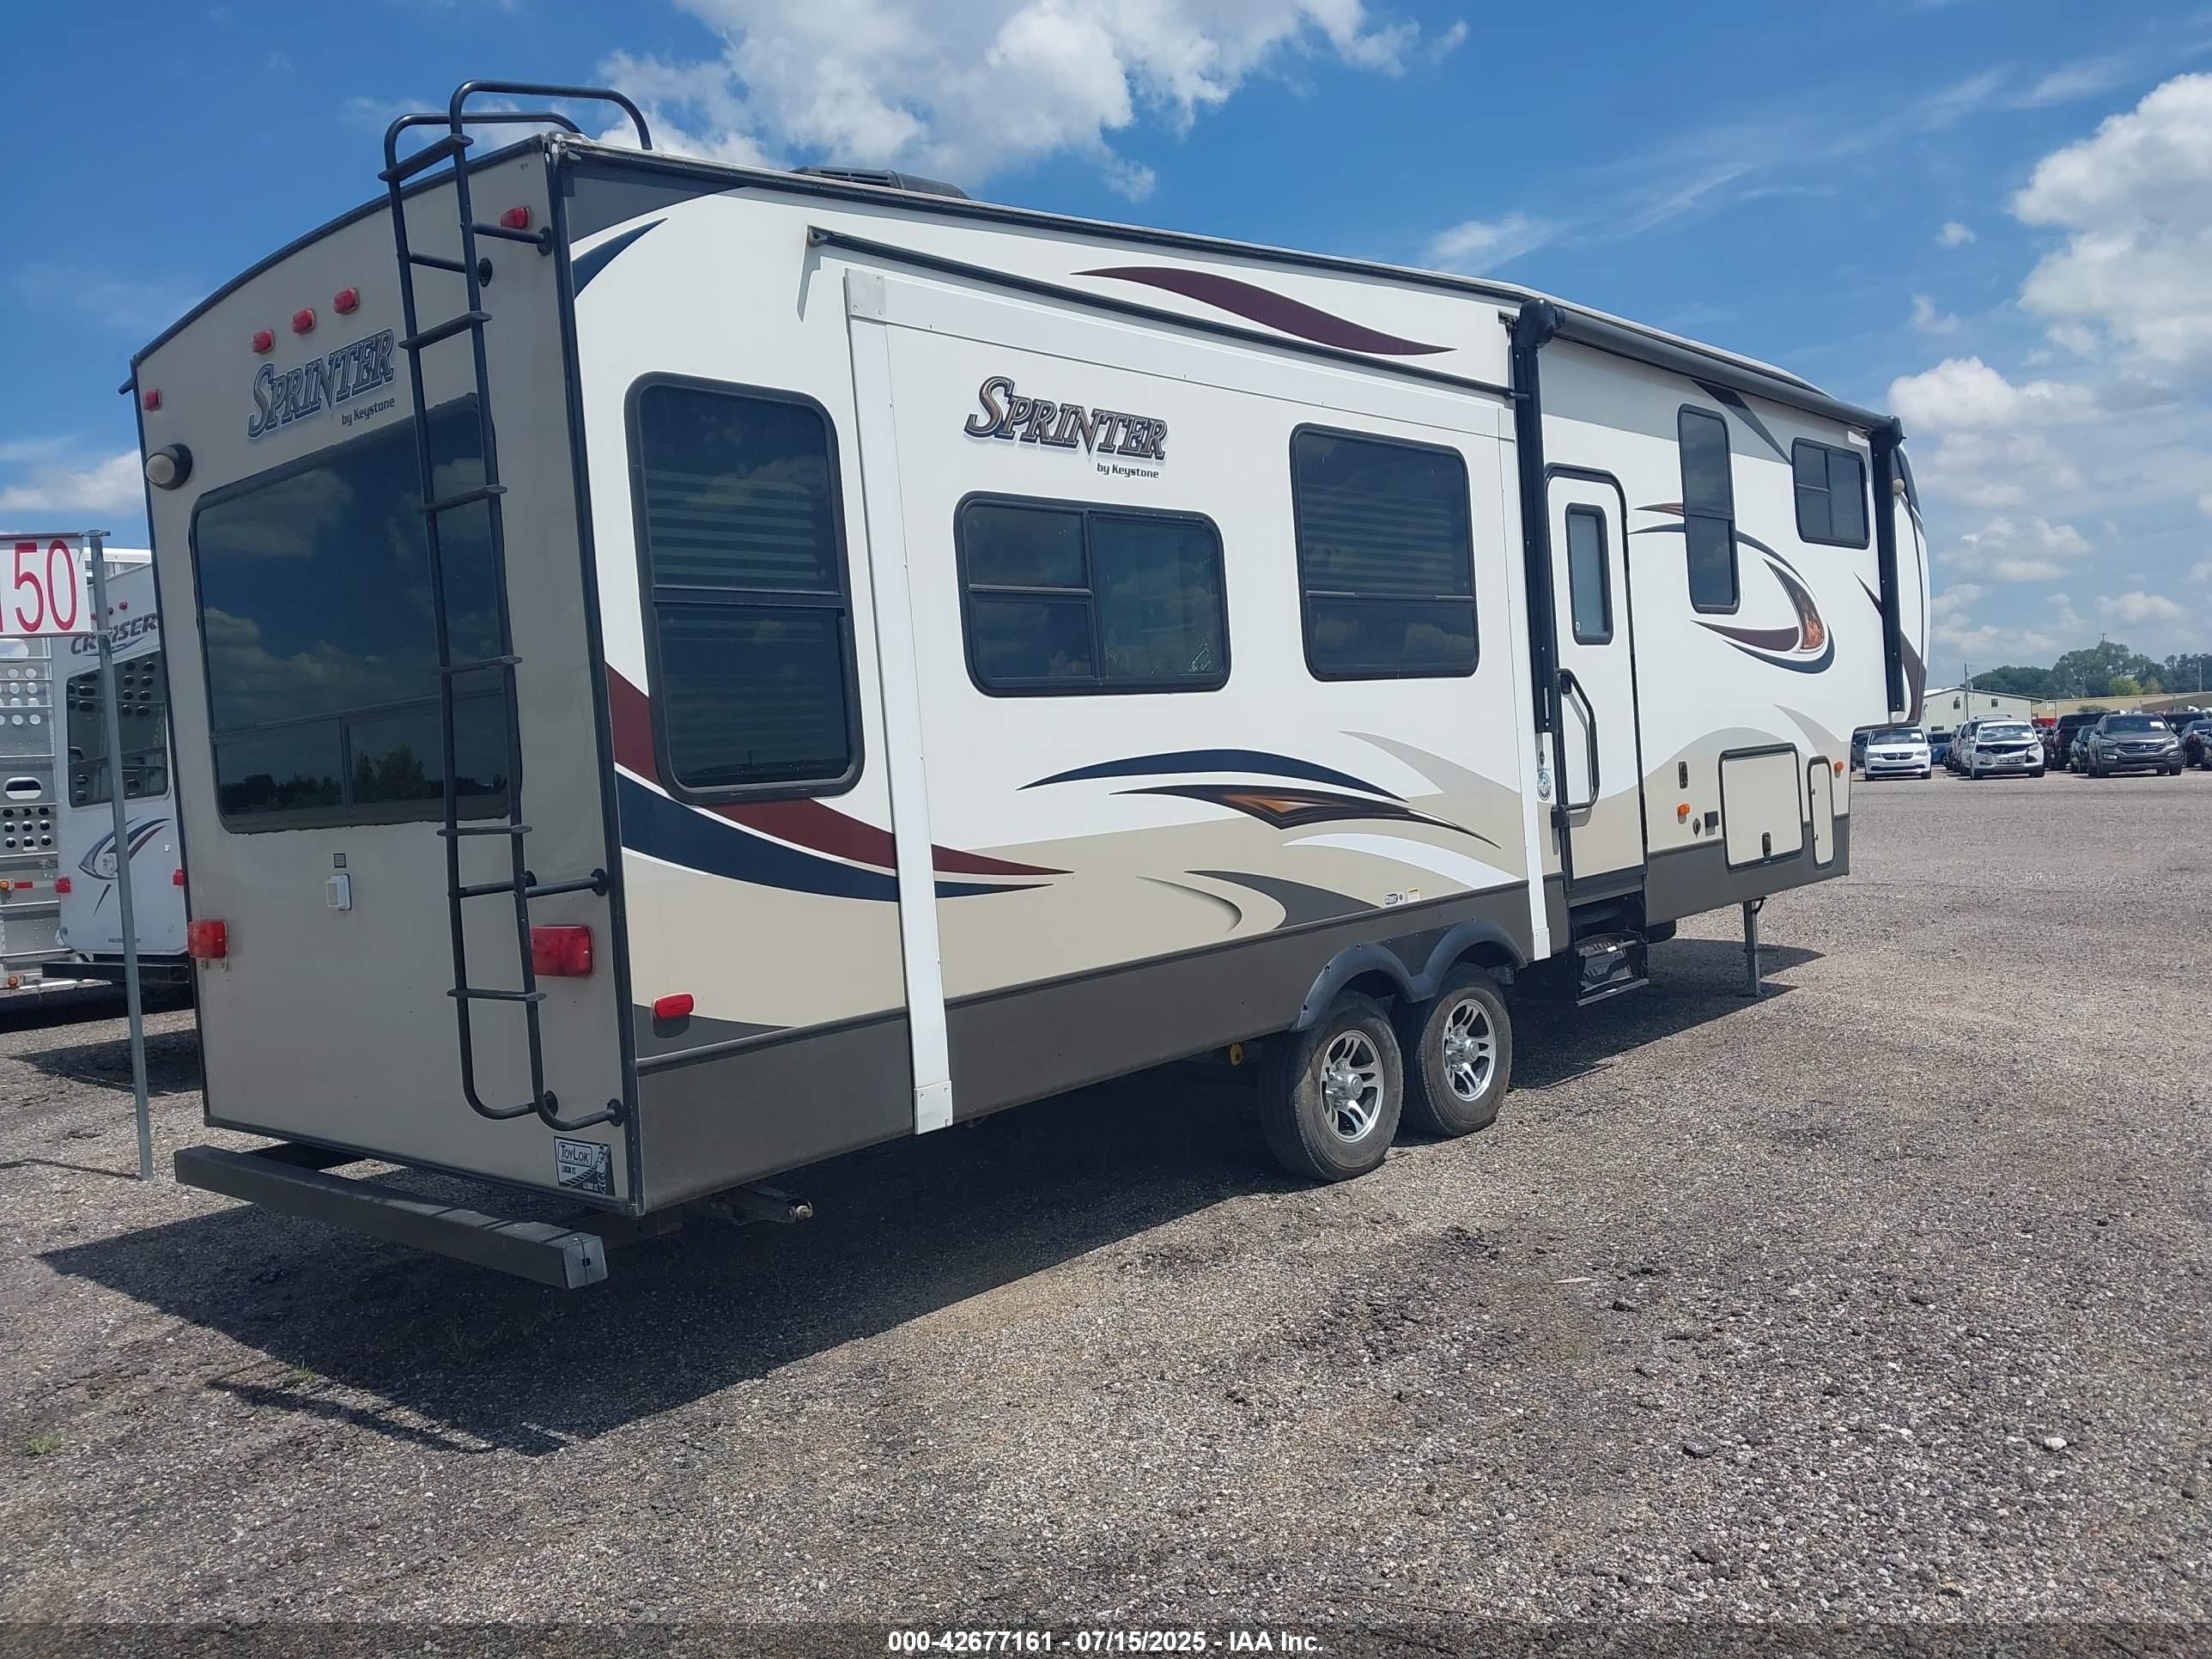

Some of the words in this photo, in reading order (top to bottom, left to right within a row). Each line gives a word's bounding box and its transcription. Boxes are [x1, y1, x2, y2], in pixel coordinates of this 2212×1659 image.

[248, 328, 394, 438] SPRINTER
[342, 414, 352, 426] by
[354, 398, 395, 421] Keystone
[963, 376, 1168, 460] SPRINTER
[1097, 462, 1110, 475] by
[1112, 464, 1160, 478] Keystone
[0, 539, 77, 633] 50
[70, 612, 158, 654] CRISER
